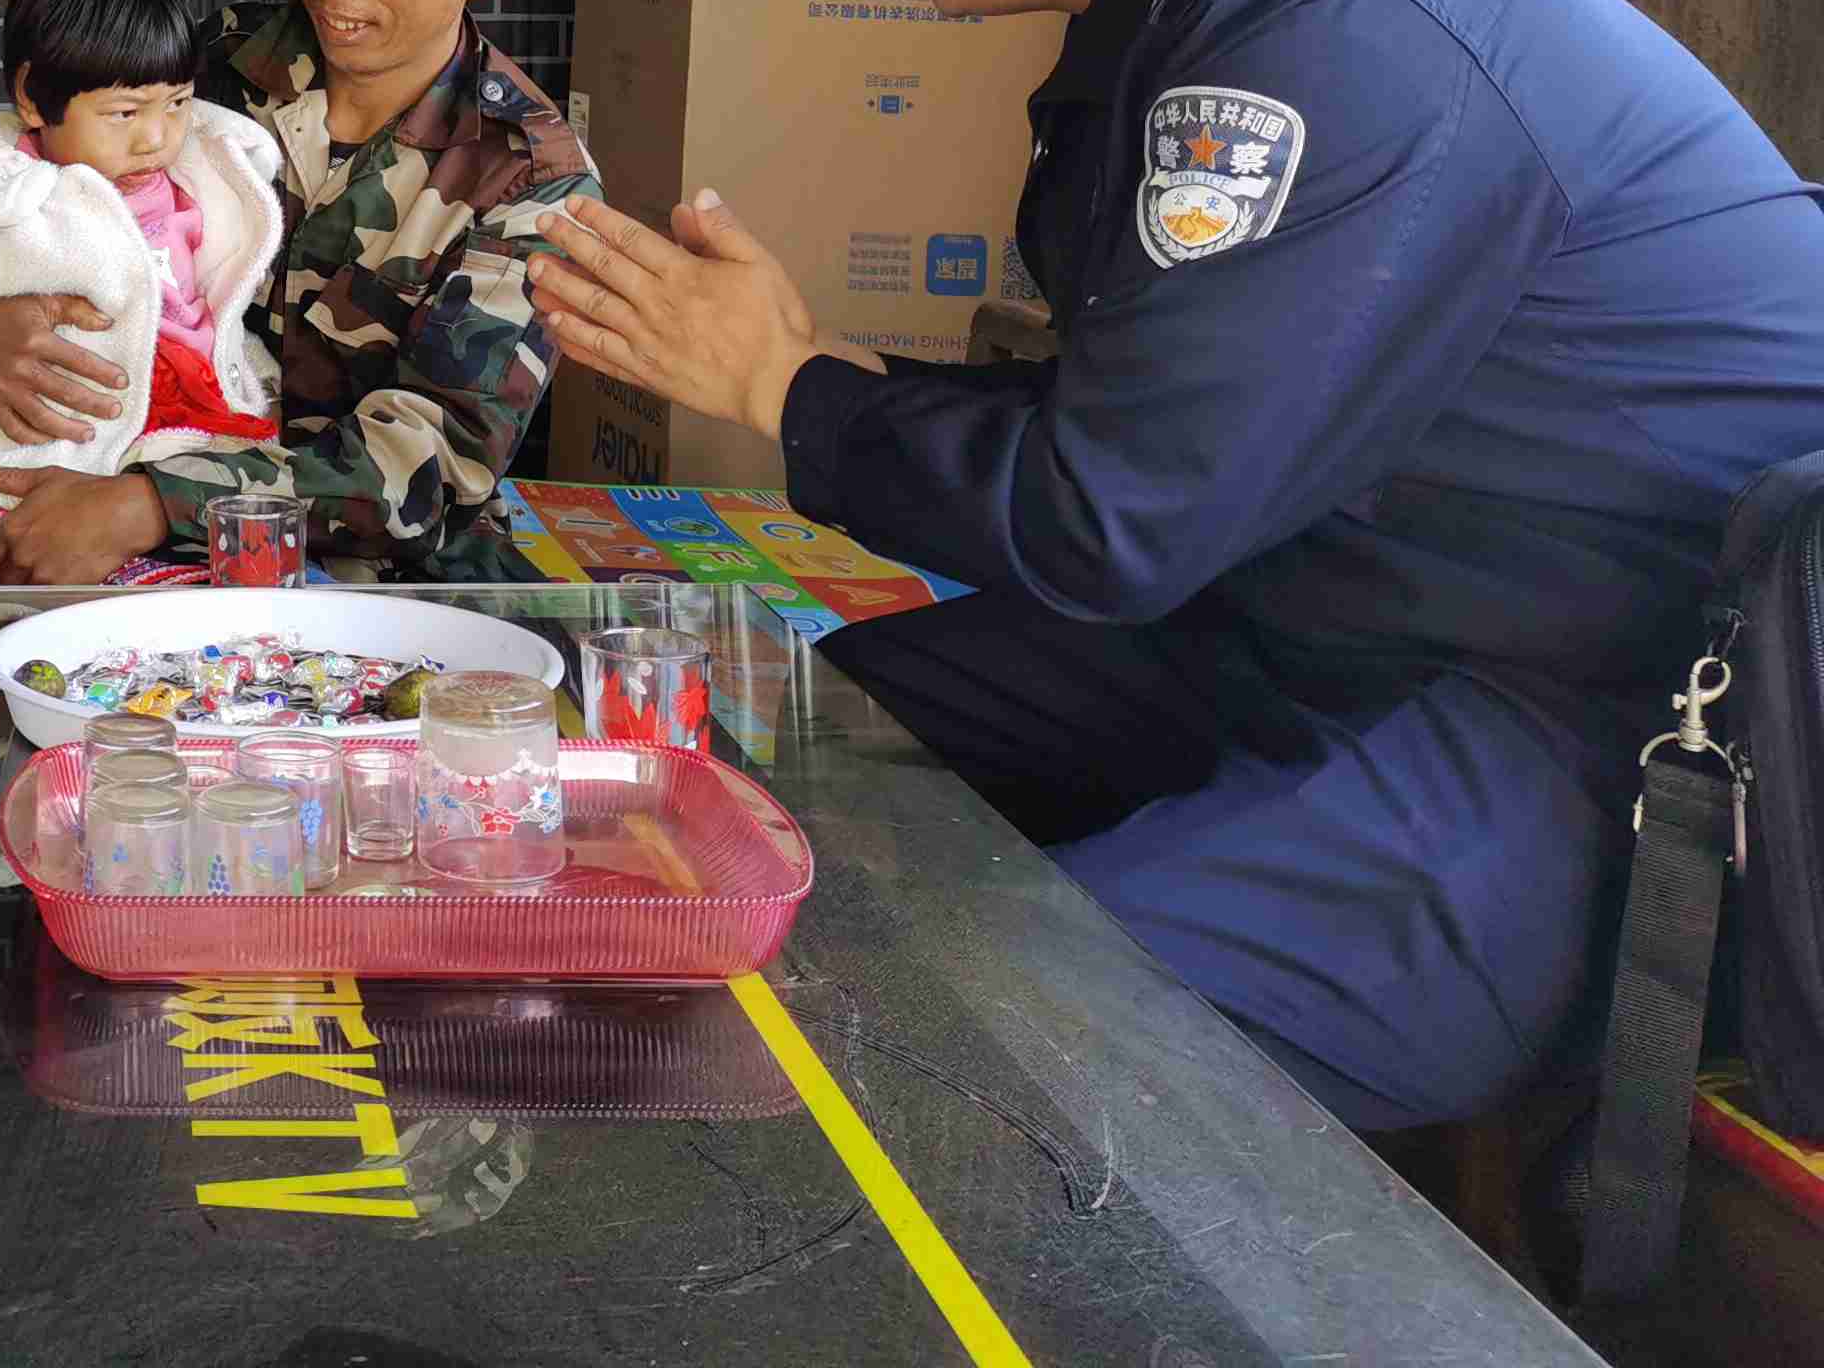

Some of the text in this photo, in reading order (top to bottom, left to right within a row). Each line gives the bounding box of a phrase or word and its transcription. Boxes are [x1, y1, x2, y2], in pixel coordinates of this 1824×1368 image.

[1154, 99, 1286, 142] 中华人民共和国
[1157, 135, 1271, 174] 警察
[1168, 170, 1232, 190] POLICE
[1173, 191, 1219, 210] 公安
[760, 521, 817, 541] C
